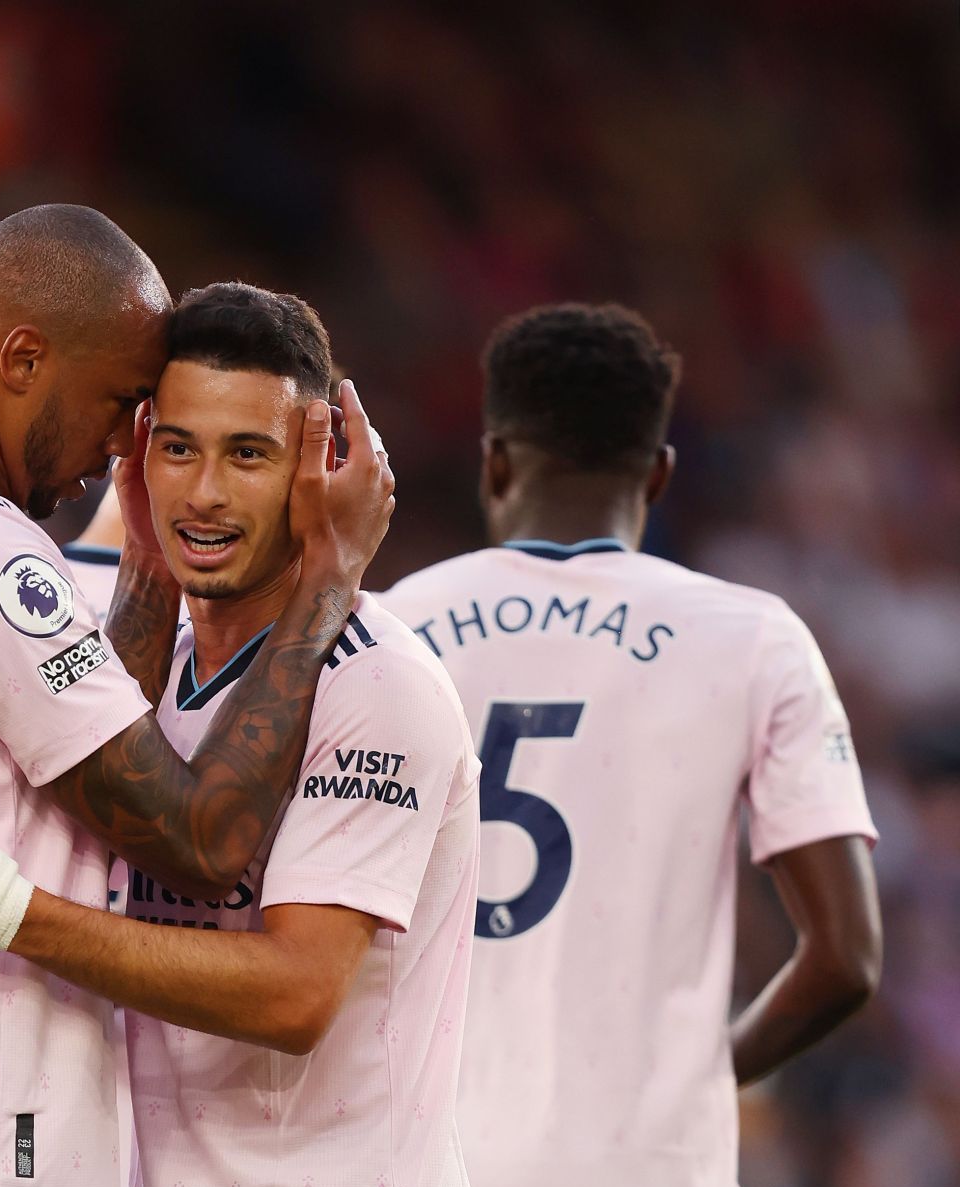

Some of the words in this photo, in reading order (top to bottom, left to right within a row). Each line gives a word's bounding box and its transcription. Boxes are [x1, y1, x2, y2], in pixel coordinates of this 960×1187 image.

[413, 596, 674, 662] THOMAS
[39, 660, 66, 678] No
[63, 637, 101, 665] room
[47, 671, 70, 694] for
[70, 648, 109, 679] racism
[335, 748, 405, 777] VISIT
[303, 776, 419, 811] RWANDA
[476, 701, 586, 941] 5
